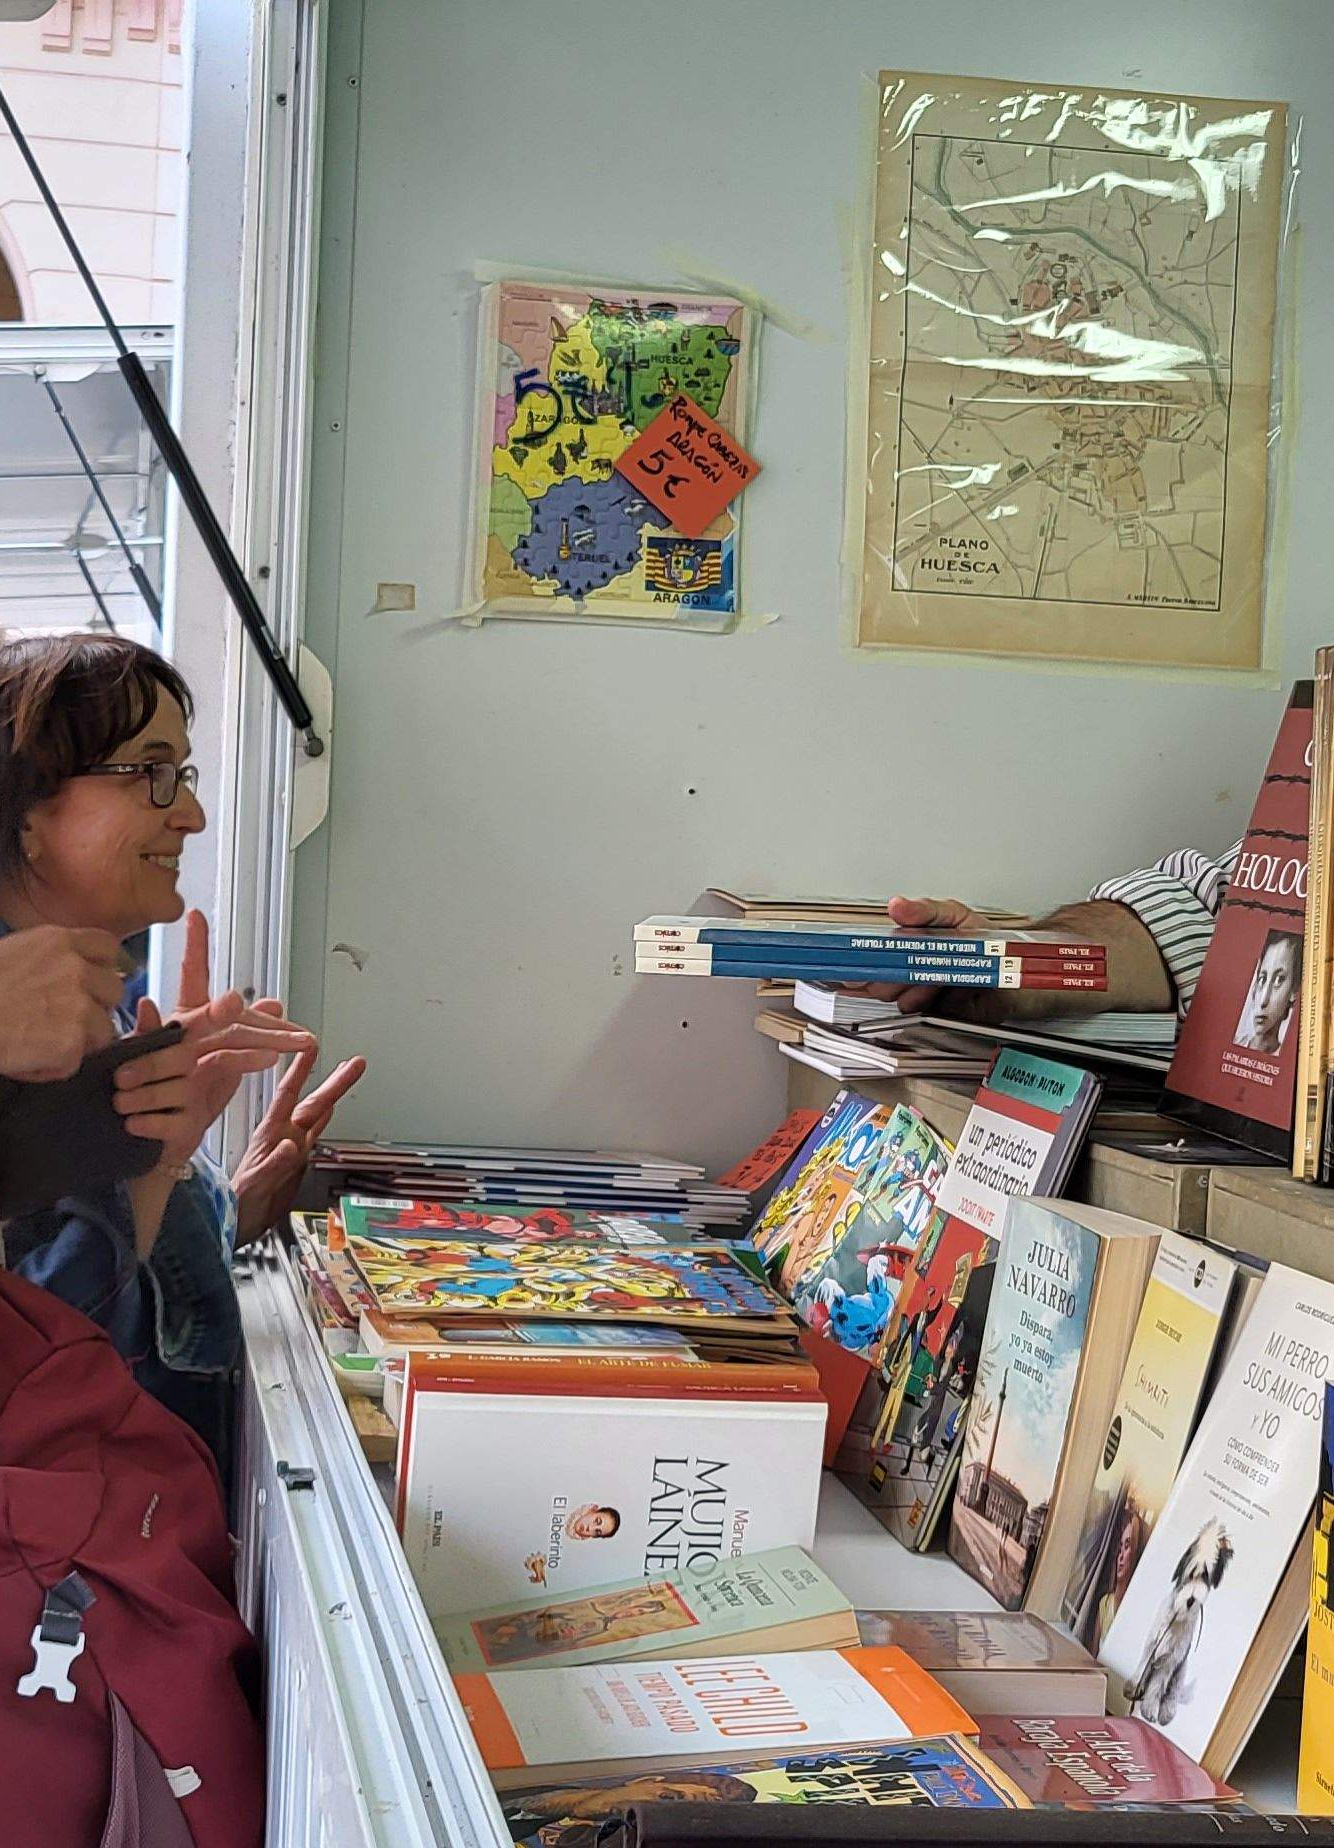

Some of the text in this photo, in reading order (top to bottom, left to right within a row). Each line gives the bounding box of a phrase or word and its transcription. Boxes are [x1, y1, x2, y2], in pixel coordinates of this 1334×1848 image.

[650, 354, 695, 366] HUESCA
[938, 537, 989, 551] PLANO
[953, 551, 970, 559] DE
[920, 557, 1000, 575] HUESCA
[968, 1123, 985, 1146] un
[985, 1131, 1038, 1171] periódico
[954, 1151, 1030, 1198] extraordinario
[1027, 1239, 1072, 1283] JULIA
[1006, 1263, 1077, 1319] NAVARRO
[1018, 1309, 1054, 1344] Dispara,
[1008, 1331, 1056, 1369] yo ya estoy
[1264, 1331, 1331, 1380] MI PERRO
[1012, 1357, 1045, 1385] muerto
[1243, 1361, 1326, 1421] SUS AMIGOS
[1258, 1408, 1281, 1440] YO
[1229, 1456, 1250, 1478] FORMA
[1256, 1470, 1270, 1488] SER
[1241, 1442, 1281, 1475] COMPRENDER
[548, 1496, 568, 1569] El laberinto
[1310, 1651, 1320, 1674] El
[673, 1659, 810, 1737] LEE CHILD
[1075, 1729, 1102, 1740] El
[1085, 1735, 1130, 1762] Arte
[1012, 1718, 1070, 1751] Baraja
[1045, 1750, 1130, 1797] Española
